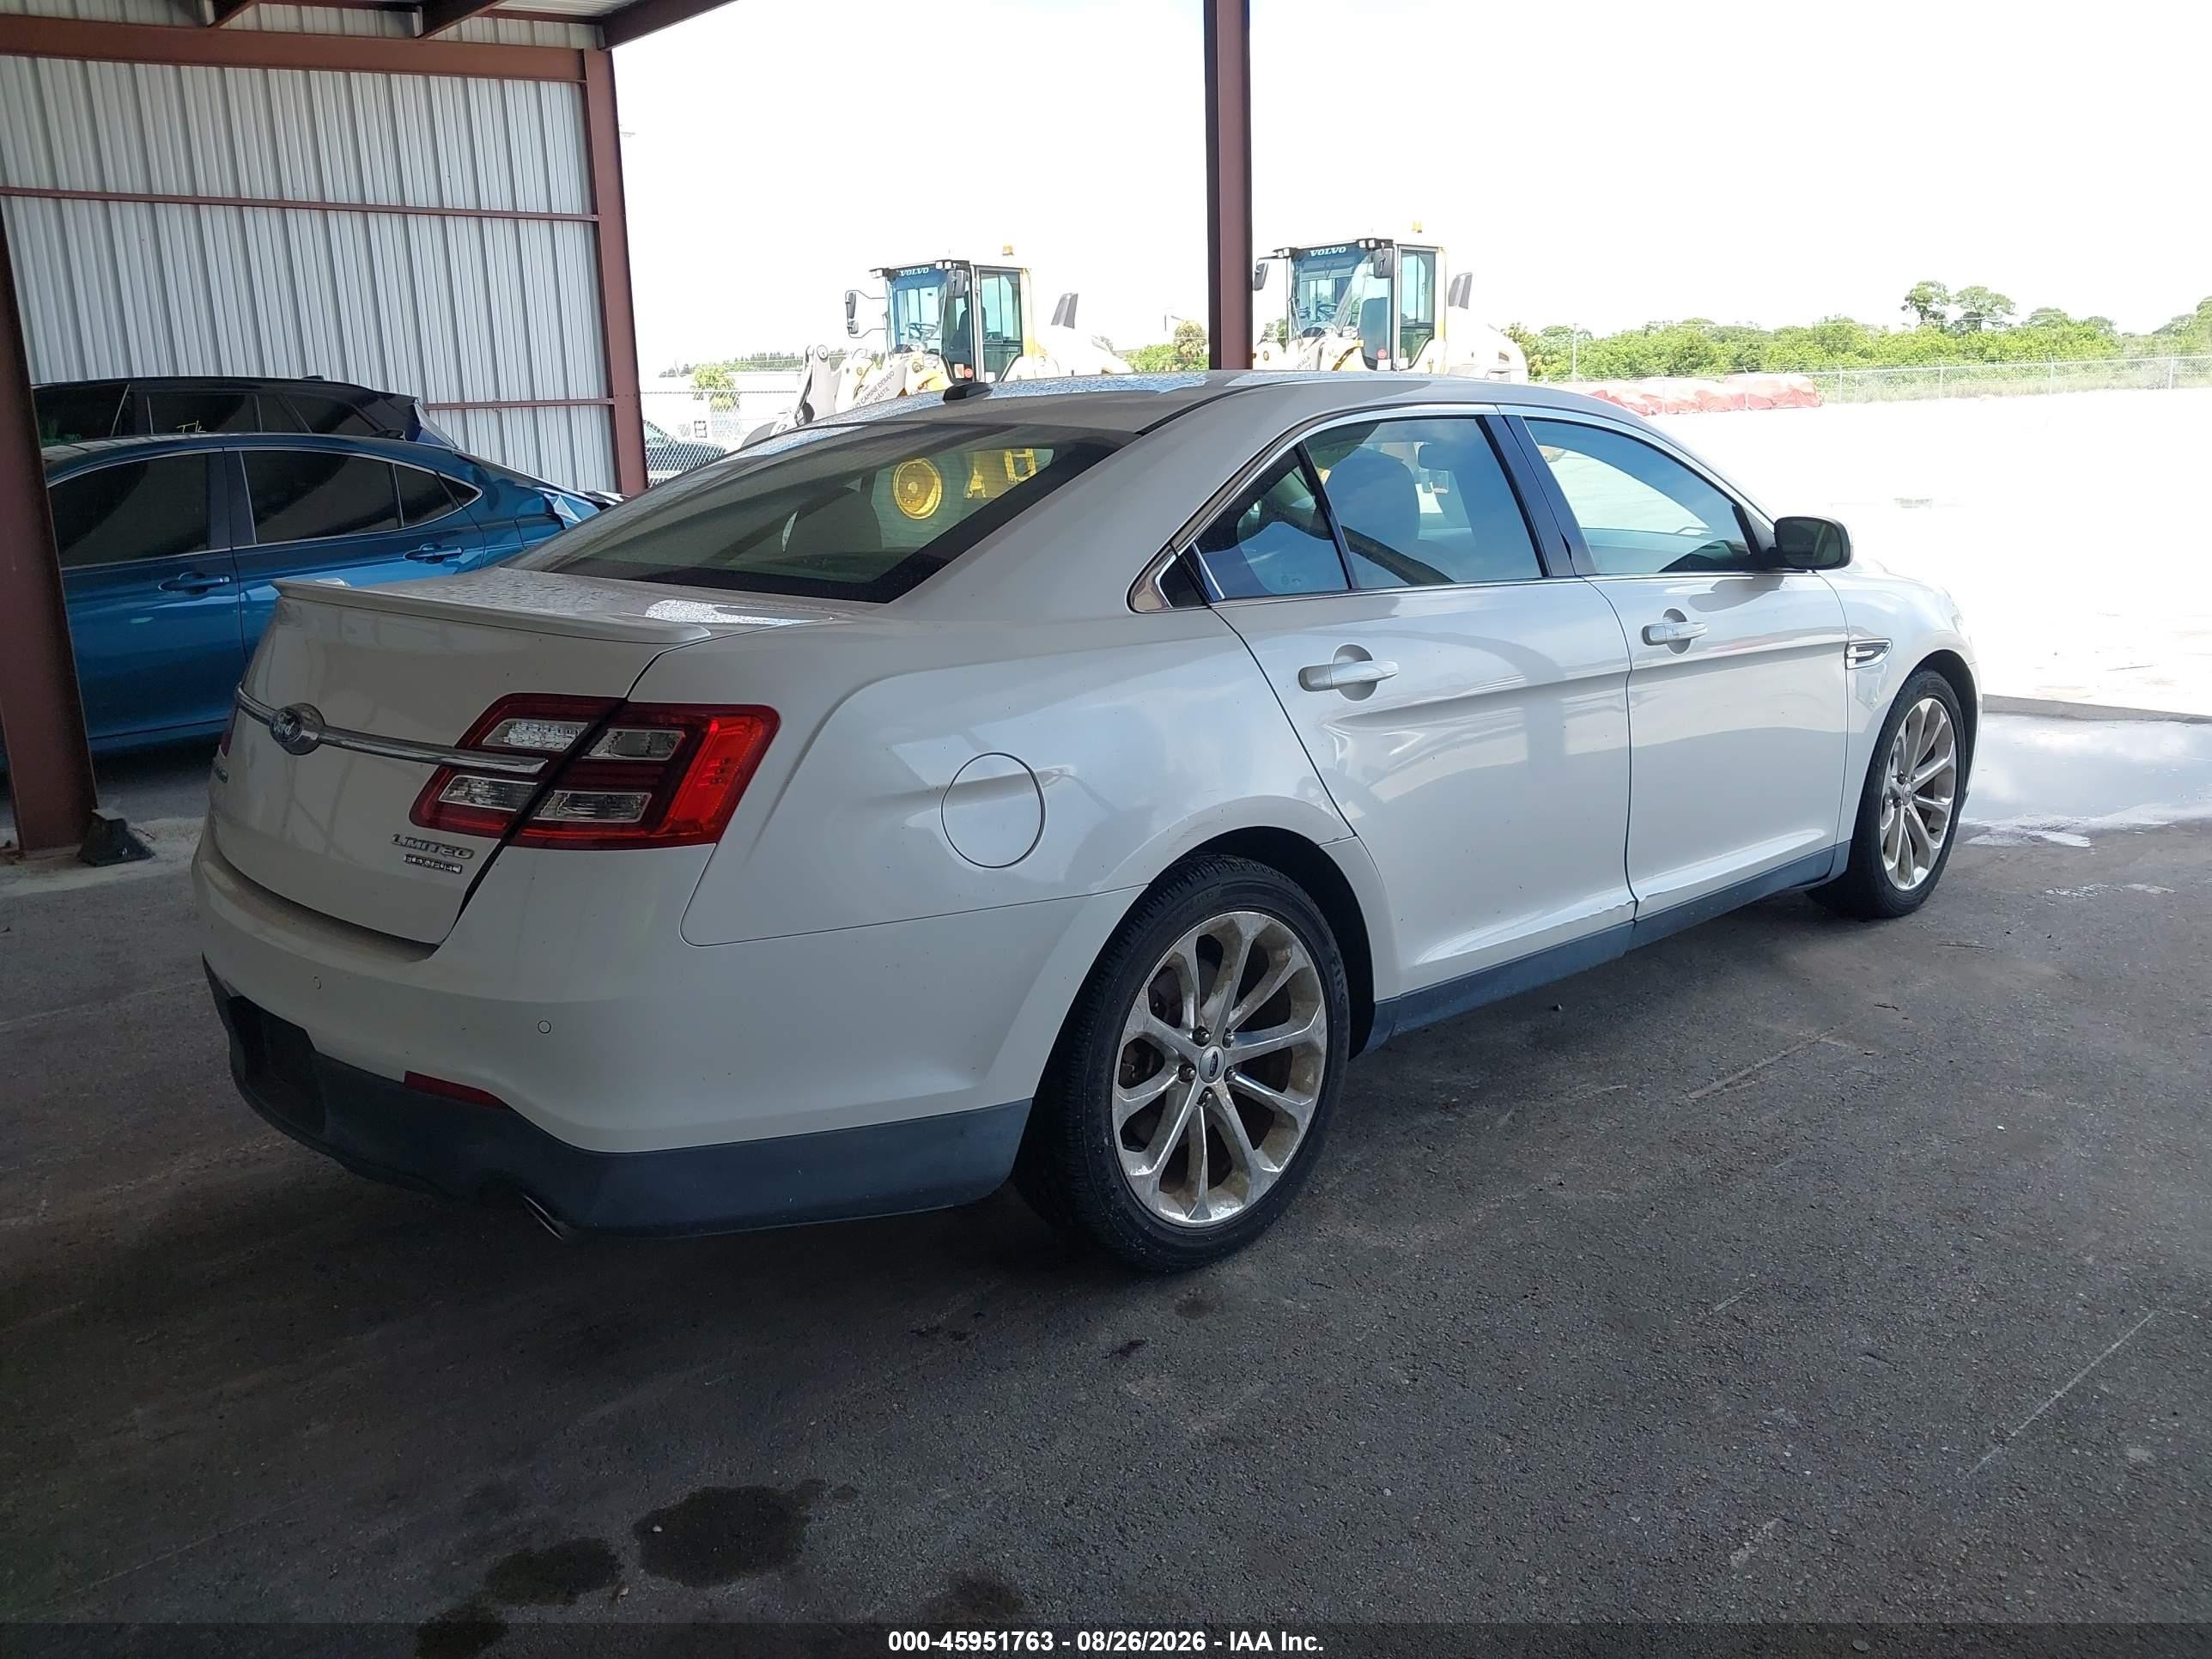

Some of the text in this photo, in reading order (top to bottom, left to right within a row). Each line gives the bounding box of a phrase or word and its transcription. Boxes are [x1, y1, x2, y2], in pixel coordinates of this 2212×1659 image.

[1309, 246, 1346, 257] VOLVO
[899, 266, 929, 276] VOLVO
[392, 833, 474, 860] LIMITED
